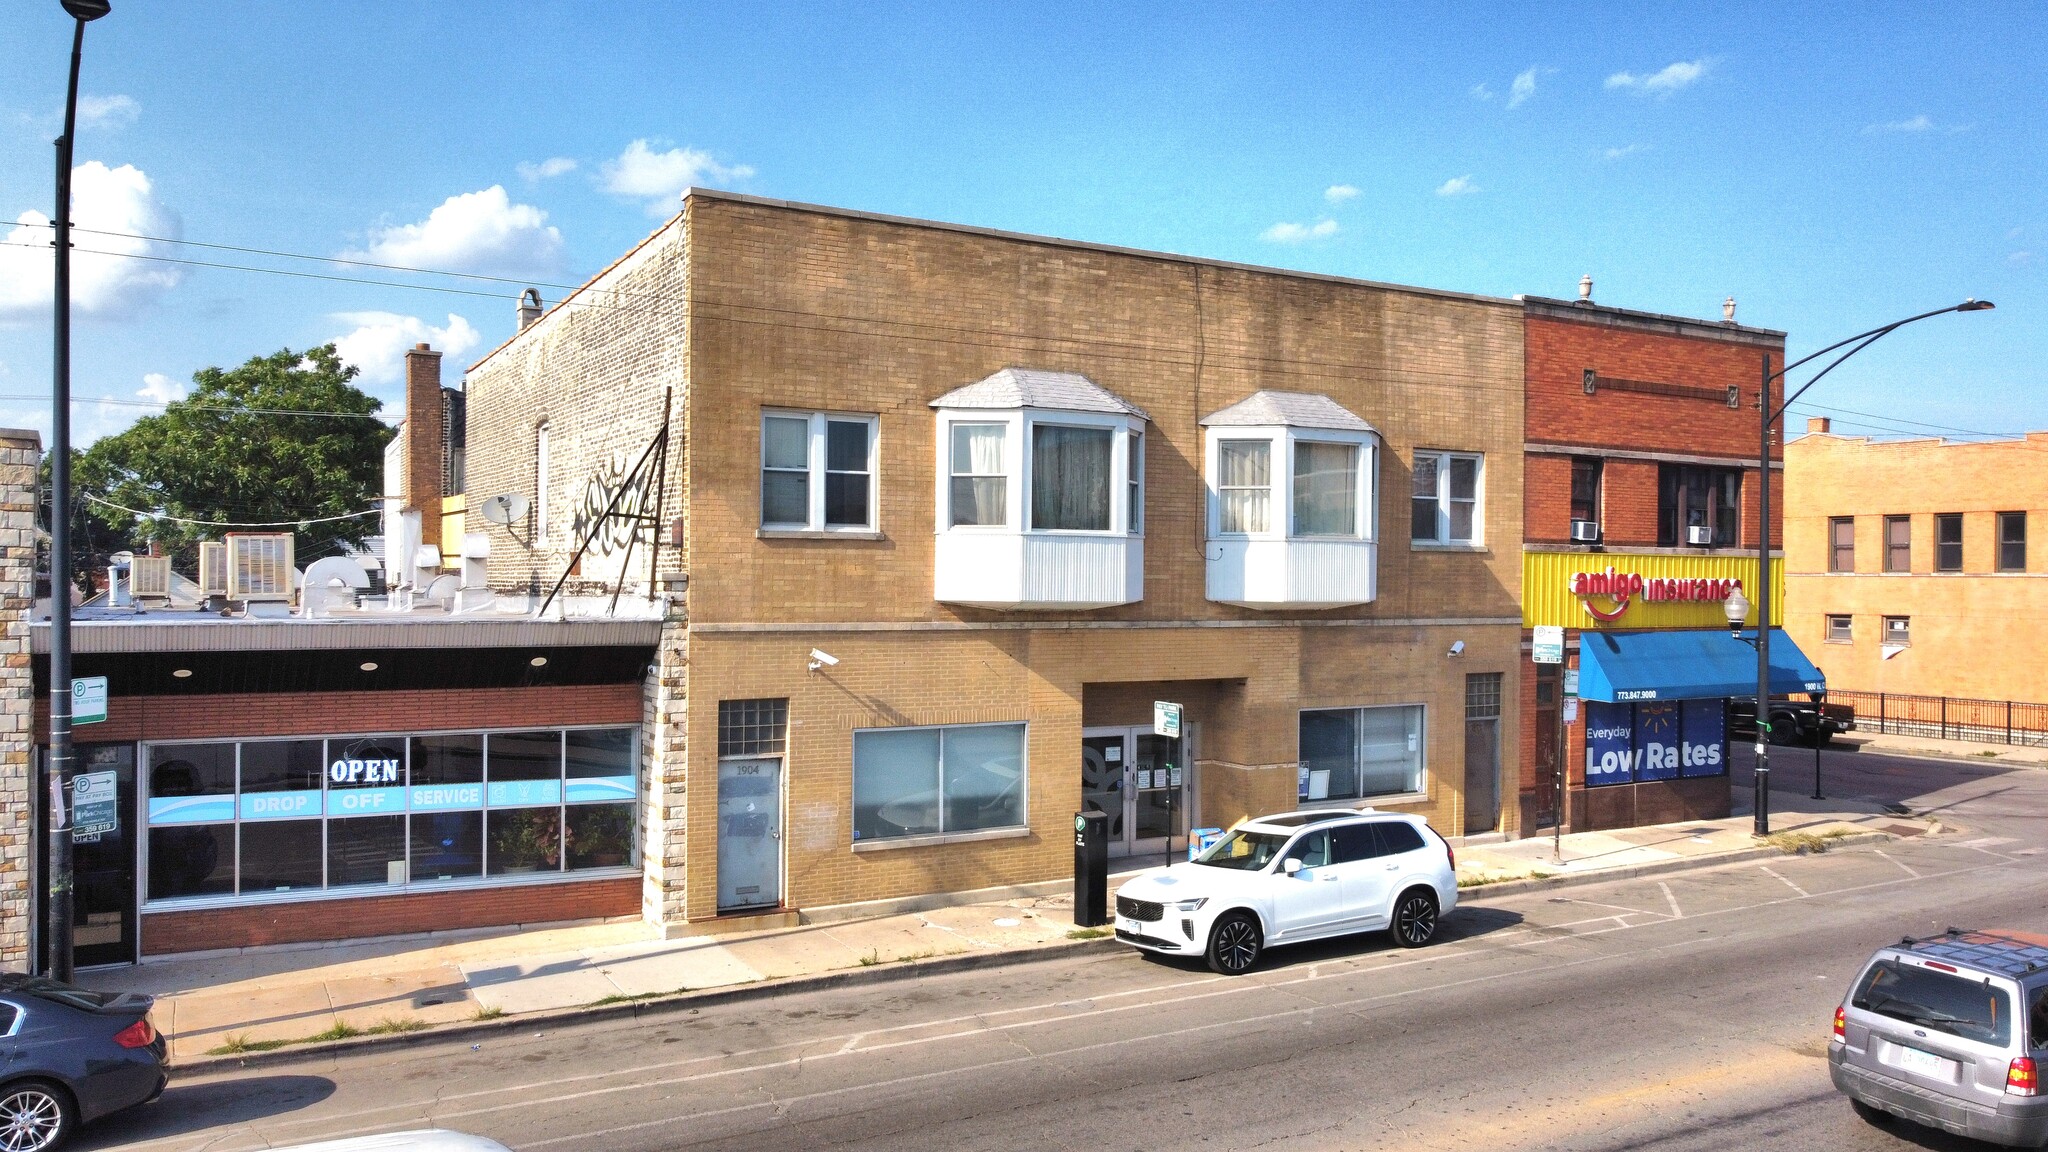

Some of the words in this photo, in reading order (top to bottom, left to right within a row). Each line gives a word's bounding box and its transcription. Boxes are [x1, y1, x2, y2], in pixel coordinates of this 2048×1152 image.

[1570, 566, 1642, 602] amigo
[1804, 682, 1817, 691] 1900
[1617, 690, 1657, 700] 773.847.9000
[1586, 726, 1631, 740] Everyday
[1586, 747, 1643, 775] Low
[1646, 741, 1721, 770] Rates
[330, 759, 399, 782] OPEN
[736, 765, 759, 776] 1904
[79, 781, 87, 790] P
[253, 795, 307, 813] DROP
[342, 793, 385, 809] OFF
[413, 788, 479, 806] SERVICE
